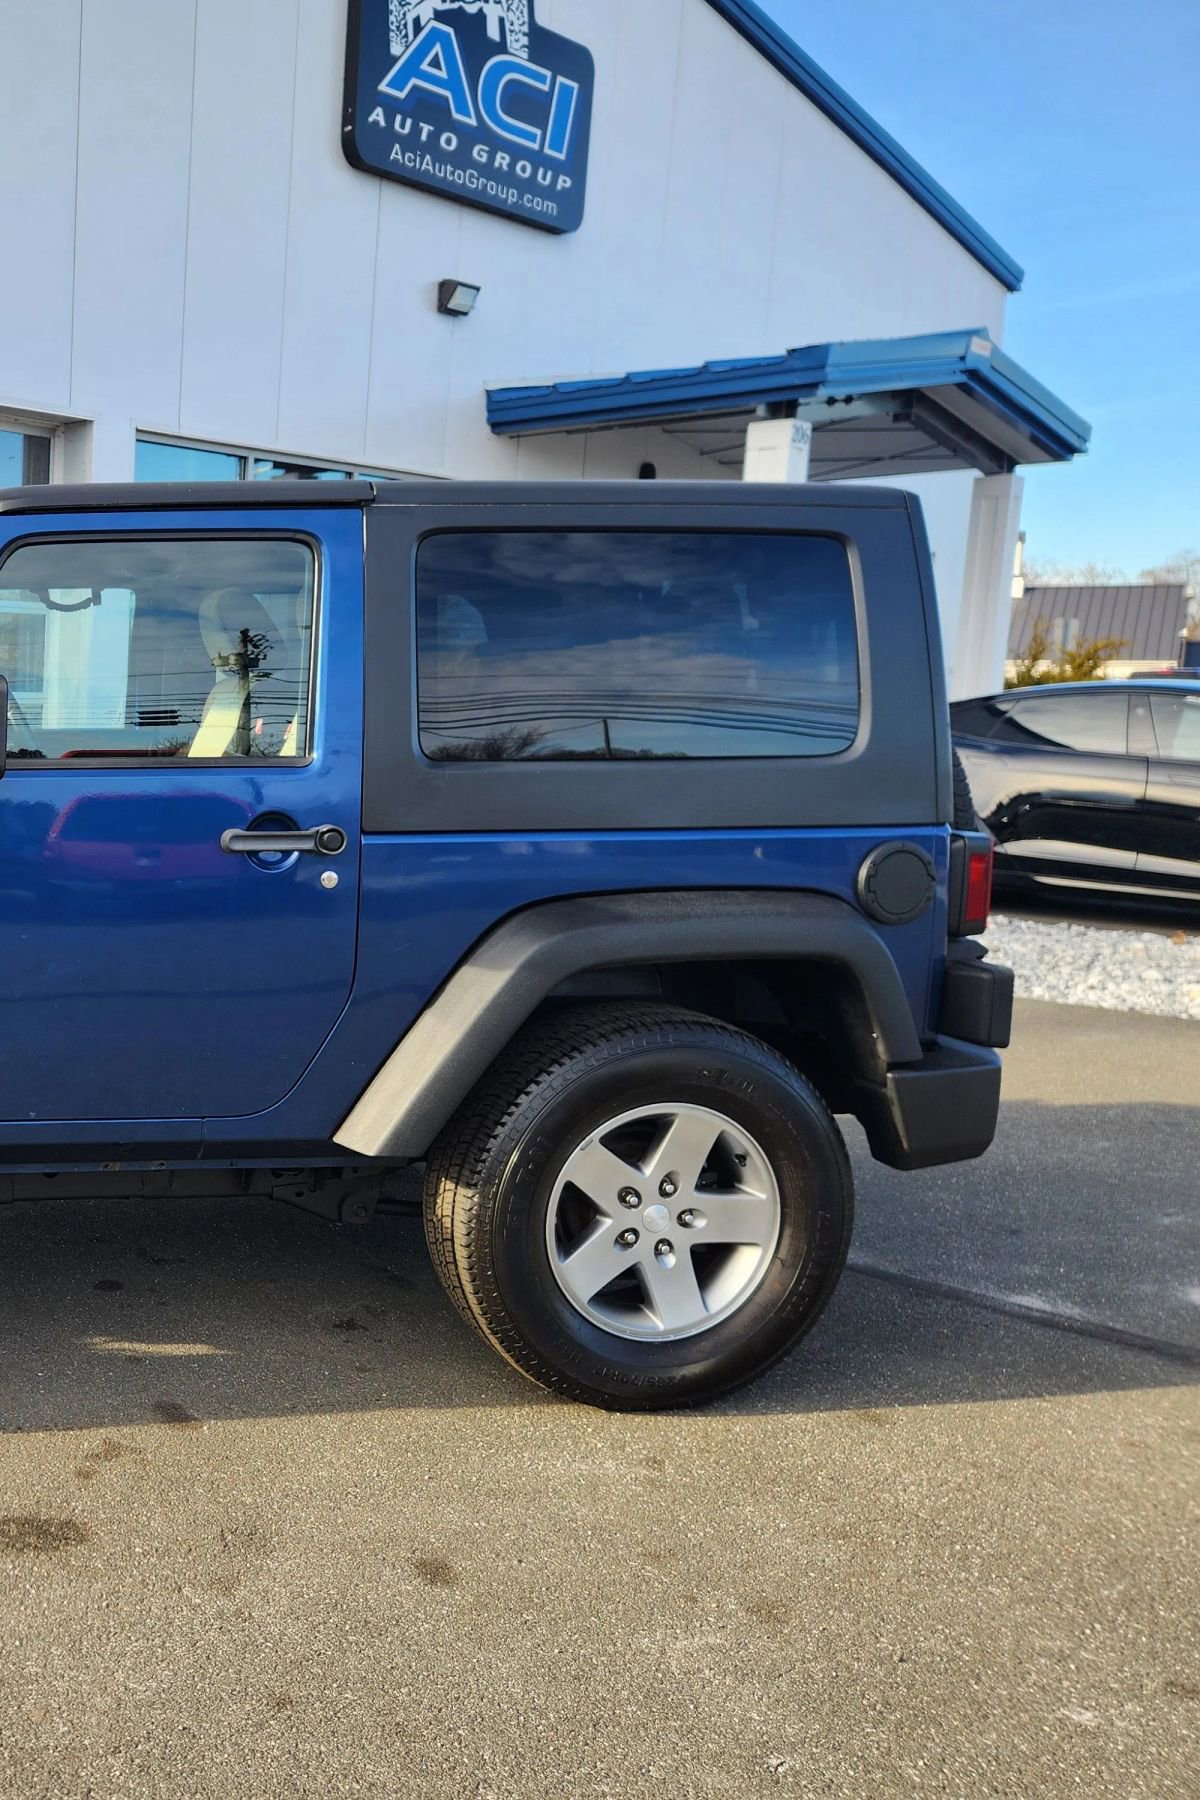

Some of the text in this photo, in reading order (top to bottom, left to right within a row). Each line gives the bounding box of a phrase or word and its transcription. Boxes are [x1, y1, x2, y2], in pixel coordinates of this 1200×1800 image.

[378, 19, 579, 160] ACI
[367, 106, 573, 192] AUTO GROUP
[390, 143, 559, 217] AciAutoGroup.com
